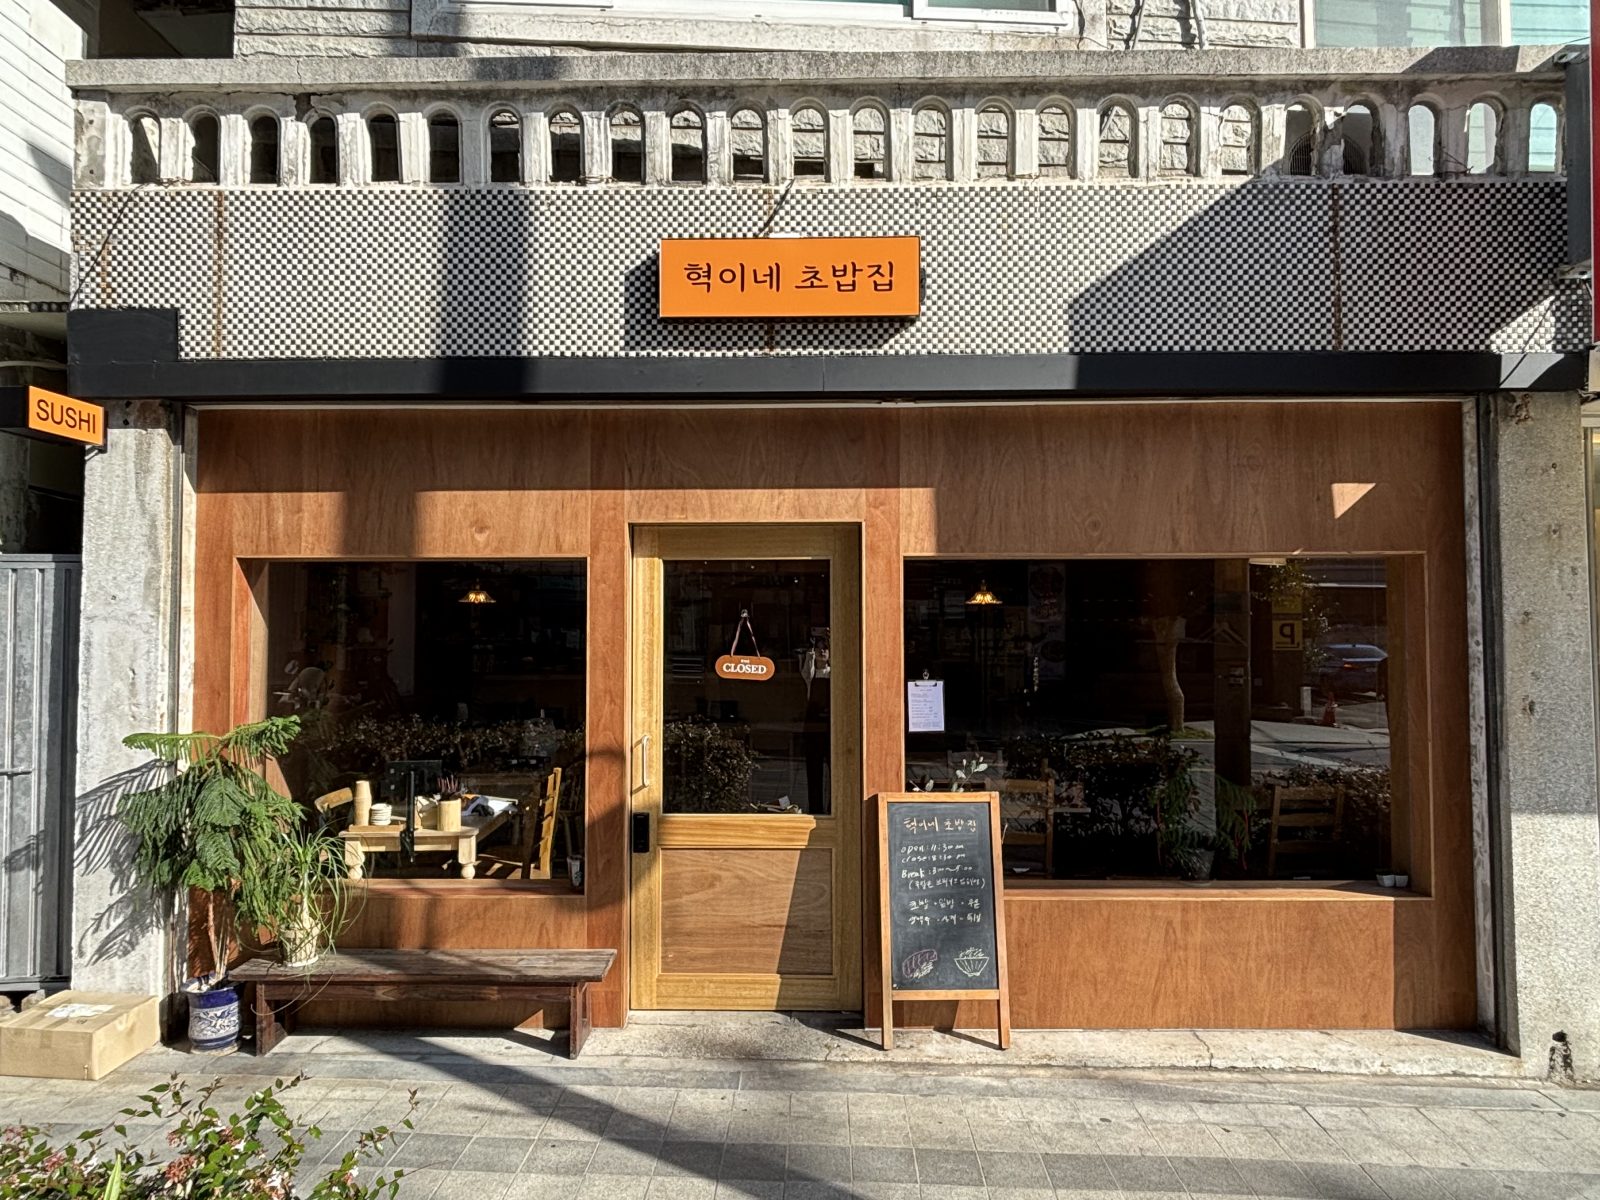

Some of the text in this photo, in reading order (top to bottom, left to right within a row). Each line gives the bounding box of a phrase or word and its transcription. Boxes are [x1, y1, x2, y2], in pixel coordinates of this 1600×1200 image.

[683, 260, 895, 293] 혁이네 초밥집
[36, 399, 95, 434] SUSHI
[722, 663, 767, 674] CLOSED
[903, 816, 939, 834] 혁이네
[901, 867, 925, 879] Break
